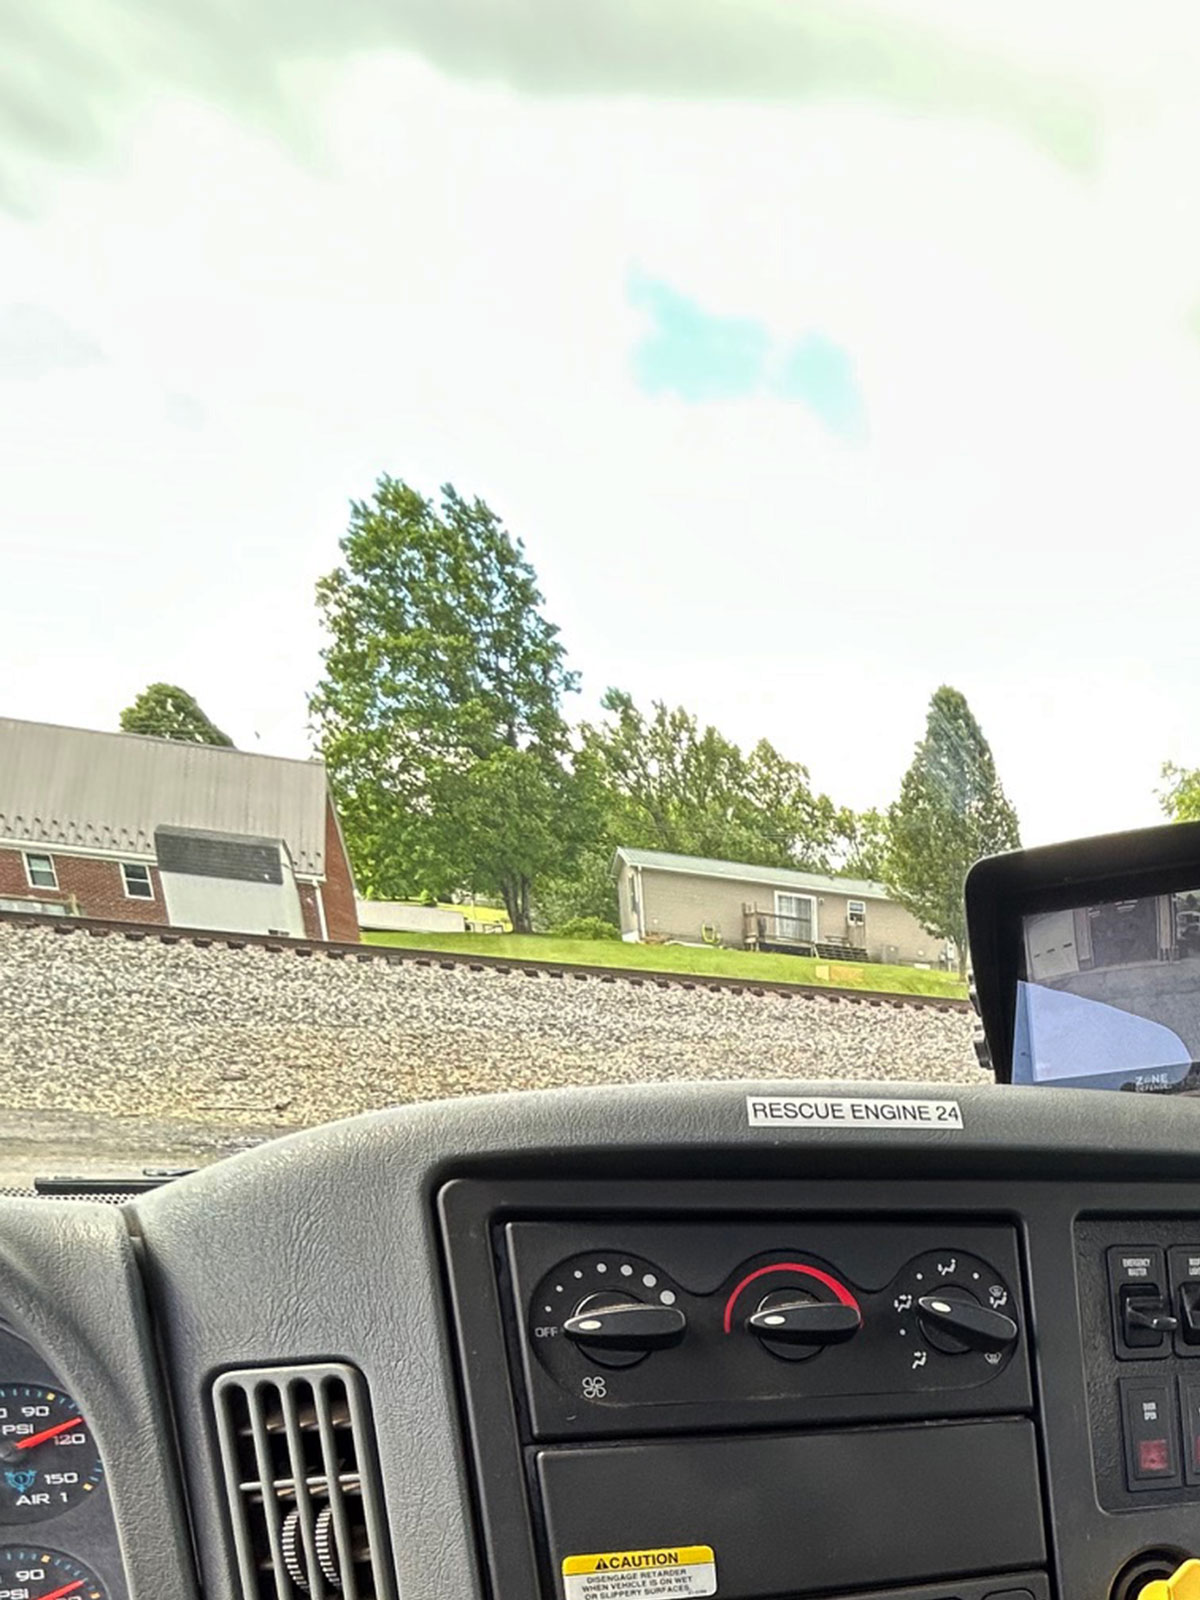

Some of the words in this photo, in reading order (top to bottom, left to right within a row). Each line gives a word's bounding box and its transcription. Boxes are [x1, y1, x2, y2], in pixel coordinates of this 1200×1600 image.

[752, 1102, 845, 1119] RESCUE
[850, 1103, 932, 1121] ENGINE
[936, 1106, 960, 1121] 24
[535, 1326, 558, 1338] OFF
[21, 1405, 50, 1418] 90
[2, 1423, 34, 1435] PSI
[53, 1433, 86, 1446] 120
[43, 1472, 79, 1485] 150
[15, 1492, 50, 1506] AIR
[60, 1491, 68, 1503] 1
[609, 1552, 680, 1570] CAUTION
[16, 1569, 45, 1582] 90
[586, 1573, 638, 1584] DISENGAGE
[640, 1569, 687, 1579] RETARDER
[582, 1582, 609, 1593] WHEN
[611, 1579, 647, 1590] VEHICLE
[649, 1578, 658, 1587] IS
[660, 1577, 673, 1586] ON
[674, 1575, 693, 1584] WET
[0, 1588, 29, 1600] PSI
[600, 1588, 643, 1600] SLIPPERY
